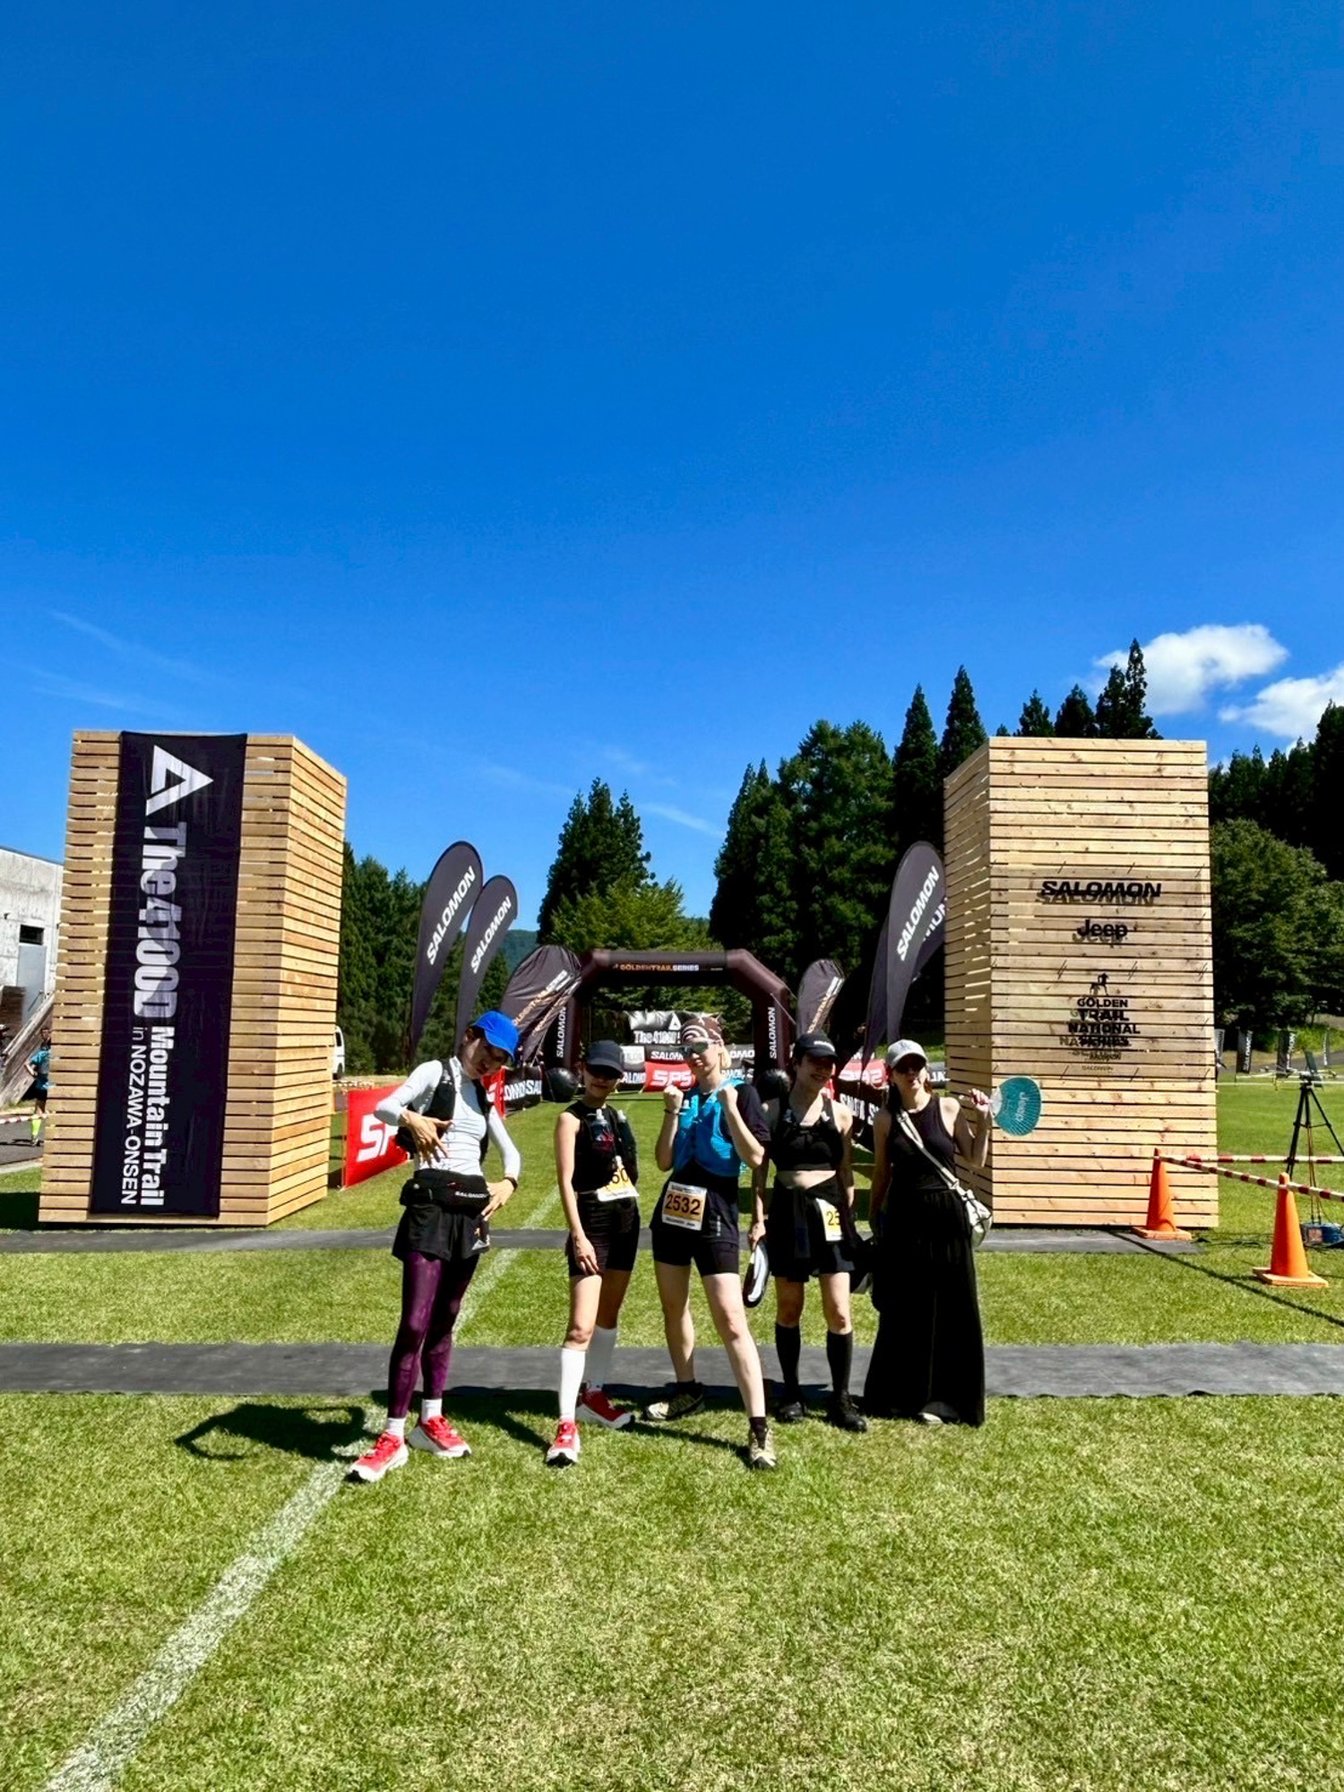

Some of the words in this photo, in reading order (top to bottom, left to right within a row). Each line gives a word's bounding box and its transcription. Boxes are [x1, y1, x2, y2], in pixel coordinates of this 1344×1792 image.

[896, 865, 939, 961] SALOMON
[1041, 881, 1162, 897] SALOMON
[426, 865, 476, 965] SALOMON
[470, 896, 512, 974] SALOMON
[1077, 919, 1128, 939] Jeep
[1077, 997, 1128, 1007] GOLDEN
[1078, 1009, 1130, 1022] TRAIL
[132, 1027, 148, 1041] in
[556, 1007, 567, 1058] SALOMON
[767, 1006, 777, 1059] SALOMON
[1068, 1022, 1141, 1034] NATIONAL
[145, 1026, 175, 1146] Mountain
[121, 1045, 147, 1204] NOZAWA-ONSEN
[140, 1149, 167, 1205] Trail
[665, 1193, 701, 1216] 2532
